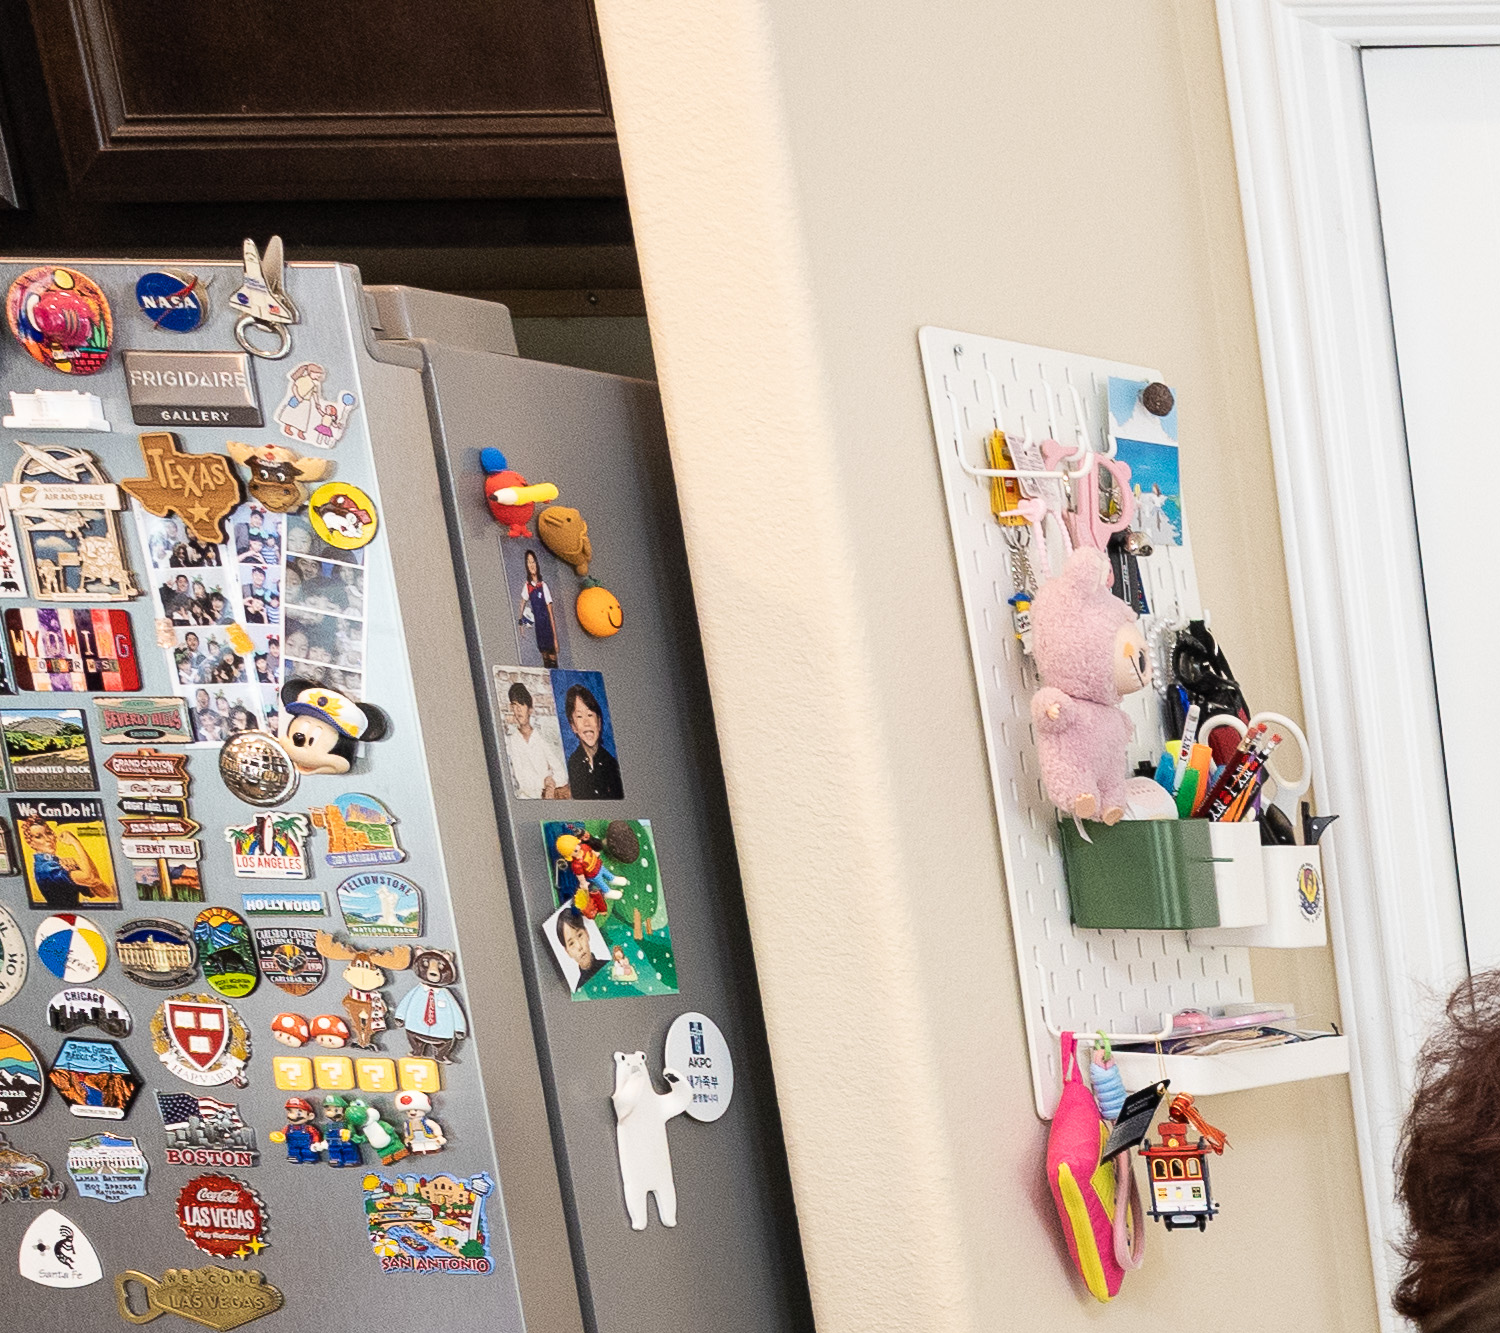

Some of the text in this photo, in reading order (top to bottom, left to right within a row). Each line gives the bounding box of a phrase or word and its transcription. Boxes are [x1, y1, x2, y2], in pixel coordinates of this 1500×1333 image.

[141, 295, 197, 309] NASA
[129, 370, 247, 388] FRIGIDAIRE
[161, 410, 230, 422] GALLERY
[148, 449, 226, 498] TEXAS
[10, 628, 129, 657] WYOMING
[103, 708, 149, 730] BEVERLY
[13, 765, 91, 775] ENCHANTED ROCK
[112, 758, 174, 774] GRAND CANYON
[16, 803, 38, 816] We
[38, 803, 62, 817] Can
[63, 803, 81, 817] Do
[236, 856, 302, 870] LOS ANGELES
[341, 875, 414, 897] YELLOWSTONE
[245, 899, 321, 912] HOLLYWOOD
[289, 929, 317, 939] CAVERN
[688, 1058, 712, 1068] AKPC
[171, 1063, 233, 1084] HARVARD
[167, 1150, 253, 1165] BOSTON
[184, 1205, 256, 1230] LAS VEGAS
[381, 1257, 490, 1273] SAN ANTONIO
[38, 1269, 83, 1280] Santa Fe
[167, 1273, 257, 1286] WELCOME
[169, 1295, 207, 1310] LAS
[208, 1295, 265, 1310] VEGAS
